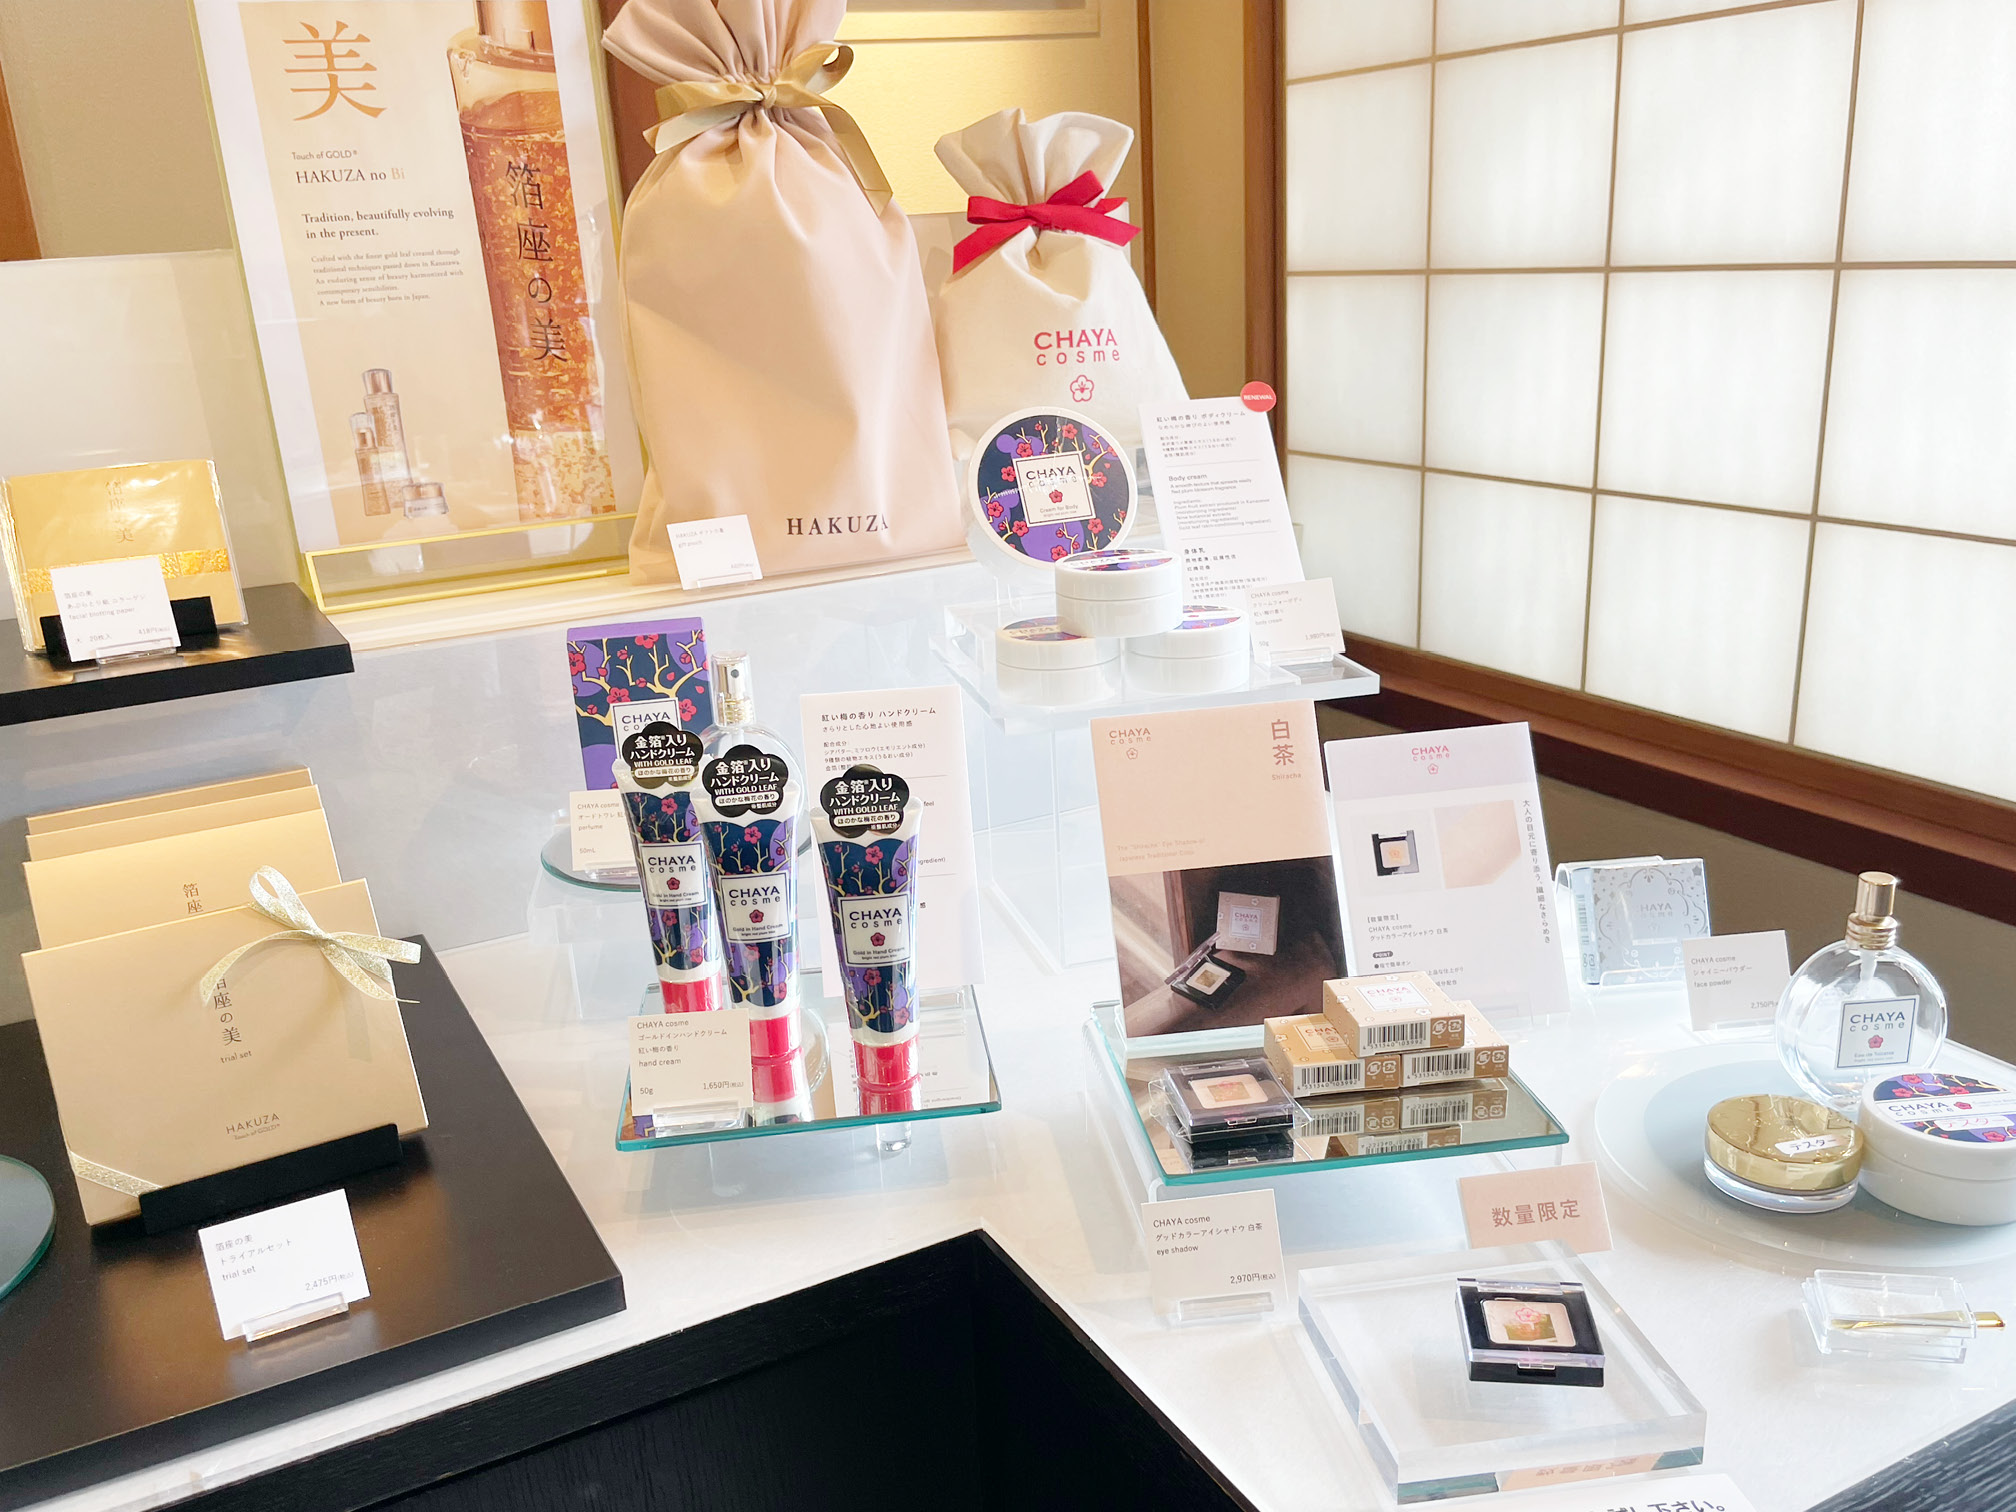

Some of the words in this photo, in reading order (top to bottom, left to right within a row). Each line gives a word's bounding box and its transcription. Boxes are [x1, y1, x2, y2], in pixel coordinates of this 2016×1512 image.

[282, 20, 388, 122] 美
[292, 151, 315, 160] Touch
[316, 151, 324, 159] of
[296, 168, 366, 184] HAKUZA
[370, 171, 387, 181] no
[391, 167, 406, 180] Bi
[301, 213, 354, 224] Tradition,
[356, 208, 410, 221] beautifully
[412, 207, 455, 219] evolving
[306, 229, 317, 239] in
[319, 228, 336, 238] the
[339, 227, 379, 242] present.
[505, 160, 568, 362] 箔座の美
[1034, 328, 1118, 350] CHAYA
[1036, 349, 1120, 366] cosme
[1026, 465, 1076, 481] CHAYA
[786, 514, 889, 536] HAKUZA
[1250, 591, 1271, 599] CHAYA
[621, 712, 671, 725] CHAYA
[821, 711, 875, 722] 紅い梅の香り
[879, 707, 937, 718] ハンドクリーム
[822, 720, 913, 733] さらりとした心地よい使用感
[1109, 727, 1151, 739] CHAYA
[823, 740, 847, 748] 配合成分
[1110, 735, 1152, 746] cosme
[1271, 718, 1295, 766] 白茶
[629, 748, 696, 761] ハンドクリーム
[1411, 745, 1449, 756] CHAYA
[633, 760, 653, 769] WITH
[654, 759, 675, 768] GOLD
[675, 757, 694, 766] LEAF
[1413, 752, 1450, 762] cosme
[709, 774, 780, 788] ハンドクリーム
[1271, 772, 1302, 781] Shiracha
[714, 788, 736, 796] WITH
[736, 786, 758, 795] GOLD
[758, 784, 778, 792] LEAF
[718, 794, 776, 805] ほのかな梅花の香り
[829, 791, 901, 807] ハンドクリーム
[577, 802, 600, 810] CHAYA
[600, 801, 620, 809] cosme
[833, 806, 855, 816] WITH
[855, 805, 878, 814] GOLD
[878, 803, 899, 812] LEAF
[578, 811, 615, 820] オードトワレ
[837, 813, 896, 825] ほのかな梅花の香り
[578, 823, 603, 832] perfume
[579, 846, 596, 854] 50mL
[647, 855, 696, 866] CHAYA
[649, 864, 697, 874] cosme
[728, 885, 781, 899] CHAYA
[182, 882, 204, 915] 箔座
[730, 895, 781, 907] cosme
[849, 907, 902, 921] CHAYA
[1234, 912, 1258, 920] CHAYA
[850, 918, 903, 929] cosme
[1368, 925, 1390, 933] CHAYA
[1391, 923, 1412, 931] cosme
[1690, 956, 1714, 965] CHAYA
[1714, 955, 1736, 963] cosme
[1693, 965, 1753, 977] シャイニーパウダー
[1709, 979, 1732, 987] powder
[1850, 1011, 1906, 1024] CHAYA
[636, 1020, 664, 1030] CHAYA
[665, 1019, 689, 1028] cosme
[1849, 1021, 1905, 1033] cosme
[638, 1028, 728, 1041] ゴールドインハンドクリーム
[638, 1044, 680, 1055] 紅い梅の香り
[220, 1051, 238, 1064] trial
[239, 1050, 252, 1059] set
[638, 1059, 658, 1068] hand
[658, 1058, 682, 1067] cream
[639, 1087, 654, 1096] 50g
[1888, 1101, 1949, 1112] CHAYA
[225, 1112, 281, 1135] HAKUZA
[1491, 1198, 1581, 1228] 数量限定
[1153, 1217, 1183, 1229] CHAYA
[1184, 1215, 1211, 1225] cosme
[1155, 1225, 1246, 1242] グッドカラーアイシャドウ
[1247, 1222, 1263, 1232] 白茶
[215, 1234, 253, 1252] 箔座の美
[220, 1238, 293, 1265] トライアルセット
[1156, 1248, 1170, 1256] eye
[1171, 1244, 1199, 1254] shadow
[222, 1269, 240, 1281] trial
[241, 1265, 257, 1277] set
[1229, 1272, 1277, 1285] 2,970円(税込)
